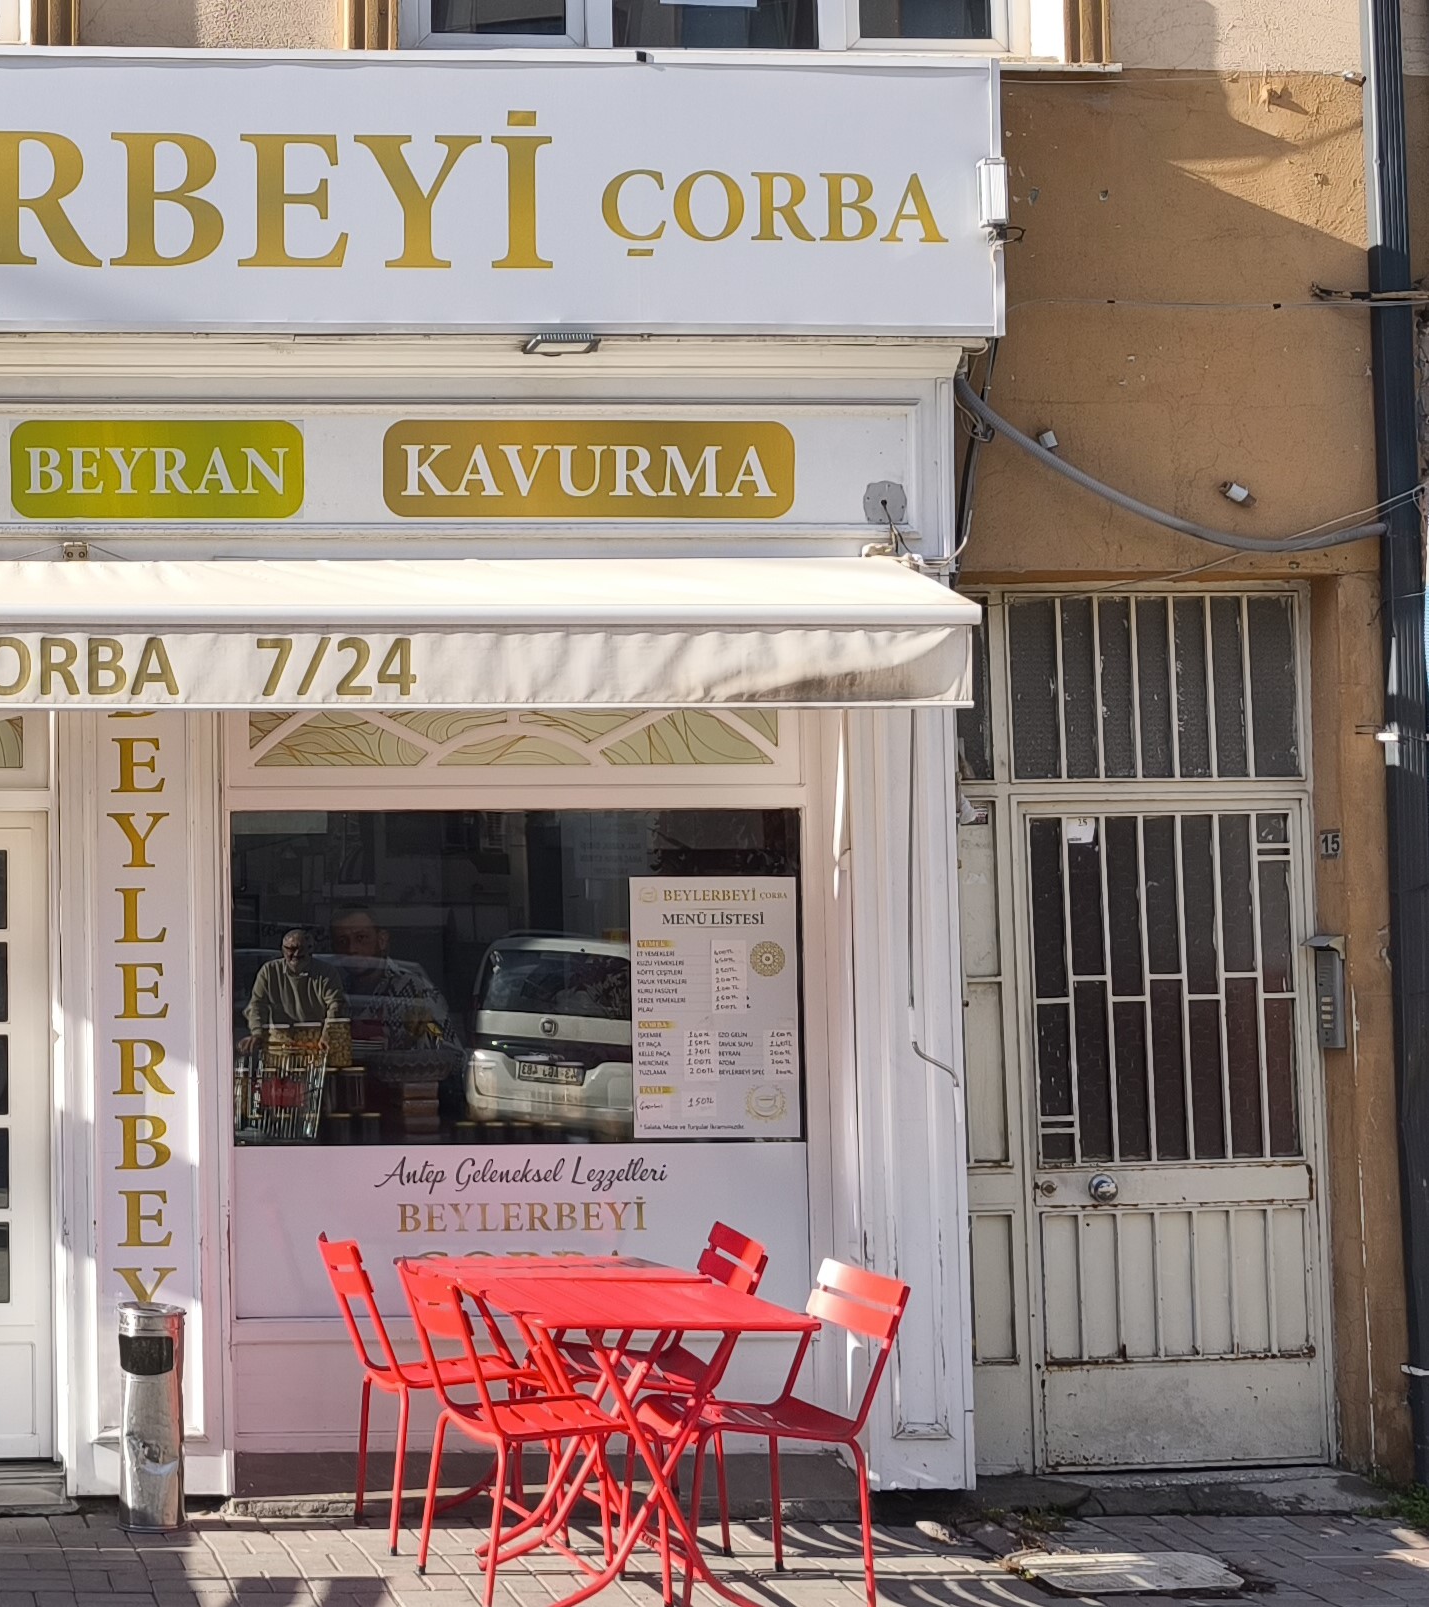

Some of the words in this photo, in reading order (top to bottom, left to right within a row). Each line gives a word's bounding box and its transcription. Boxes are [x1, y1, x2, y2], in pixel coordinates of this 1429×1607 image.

[600, 169, 949, 257] ÇORBA
[24, 445, 289, 498] BEYRAN
[400, 443, 778, 499] KAVURMA
[256, 637, 417, 697] 7/24
[1321, 834, 1340, 853] 15
[663, 887, 756, 902] BEYLERBEYİ
[662, 911, 707, 925] MENÜ
[711, 911, 765, 925] LİSTESİ
[107, 711, 177, 1303] EYLERBEY
[374, 1156, 447, 1194] Antep
[455, 1157, 565, 1192] Geleneksel
[570, 1156, 668, 1192] Lezzetleri
[397, 1196, 647, 1233] BEYLERBEYİ
